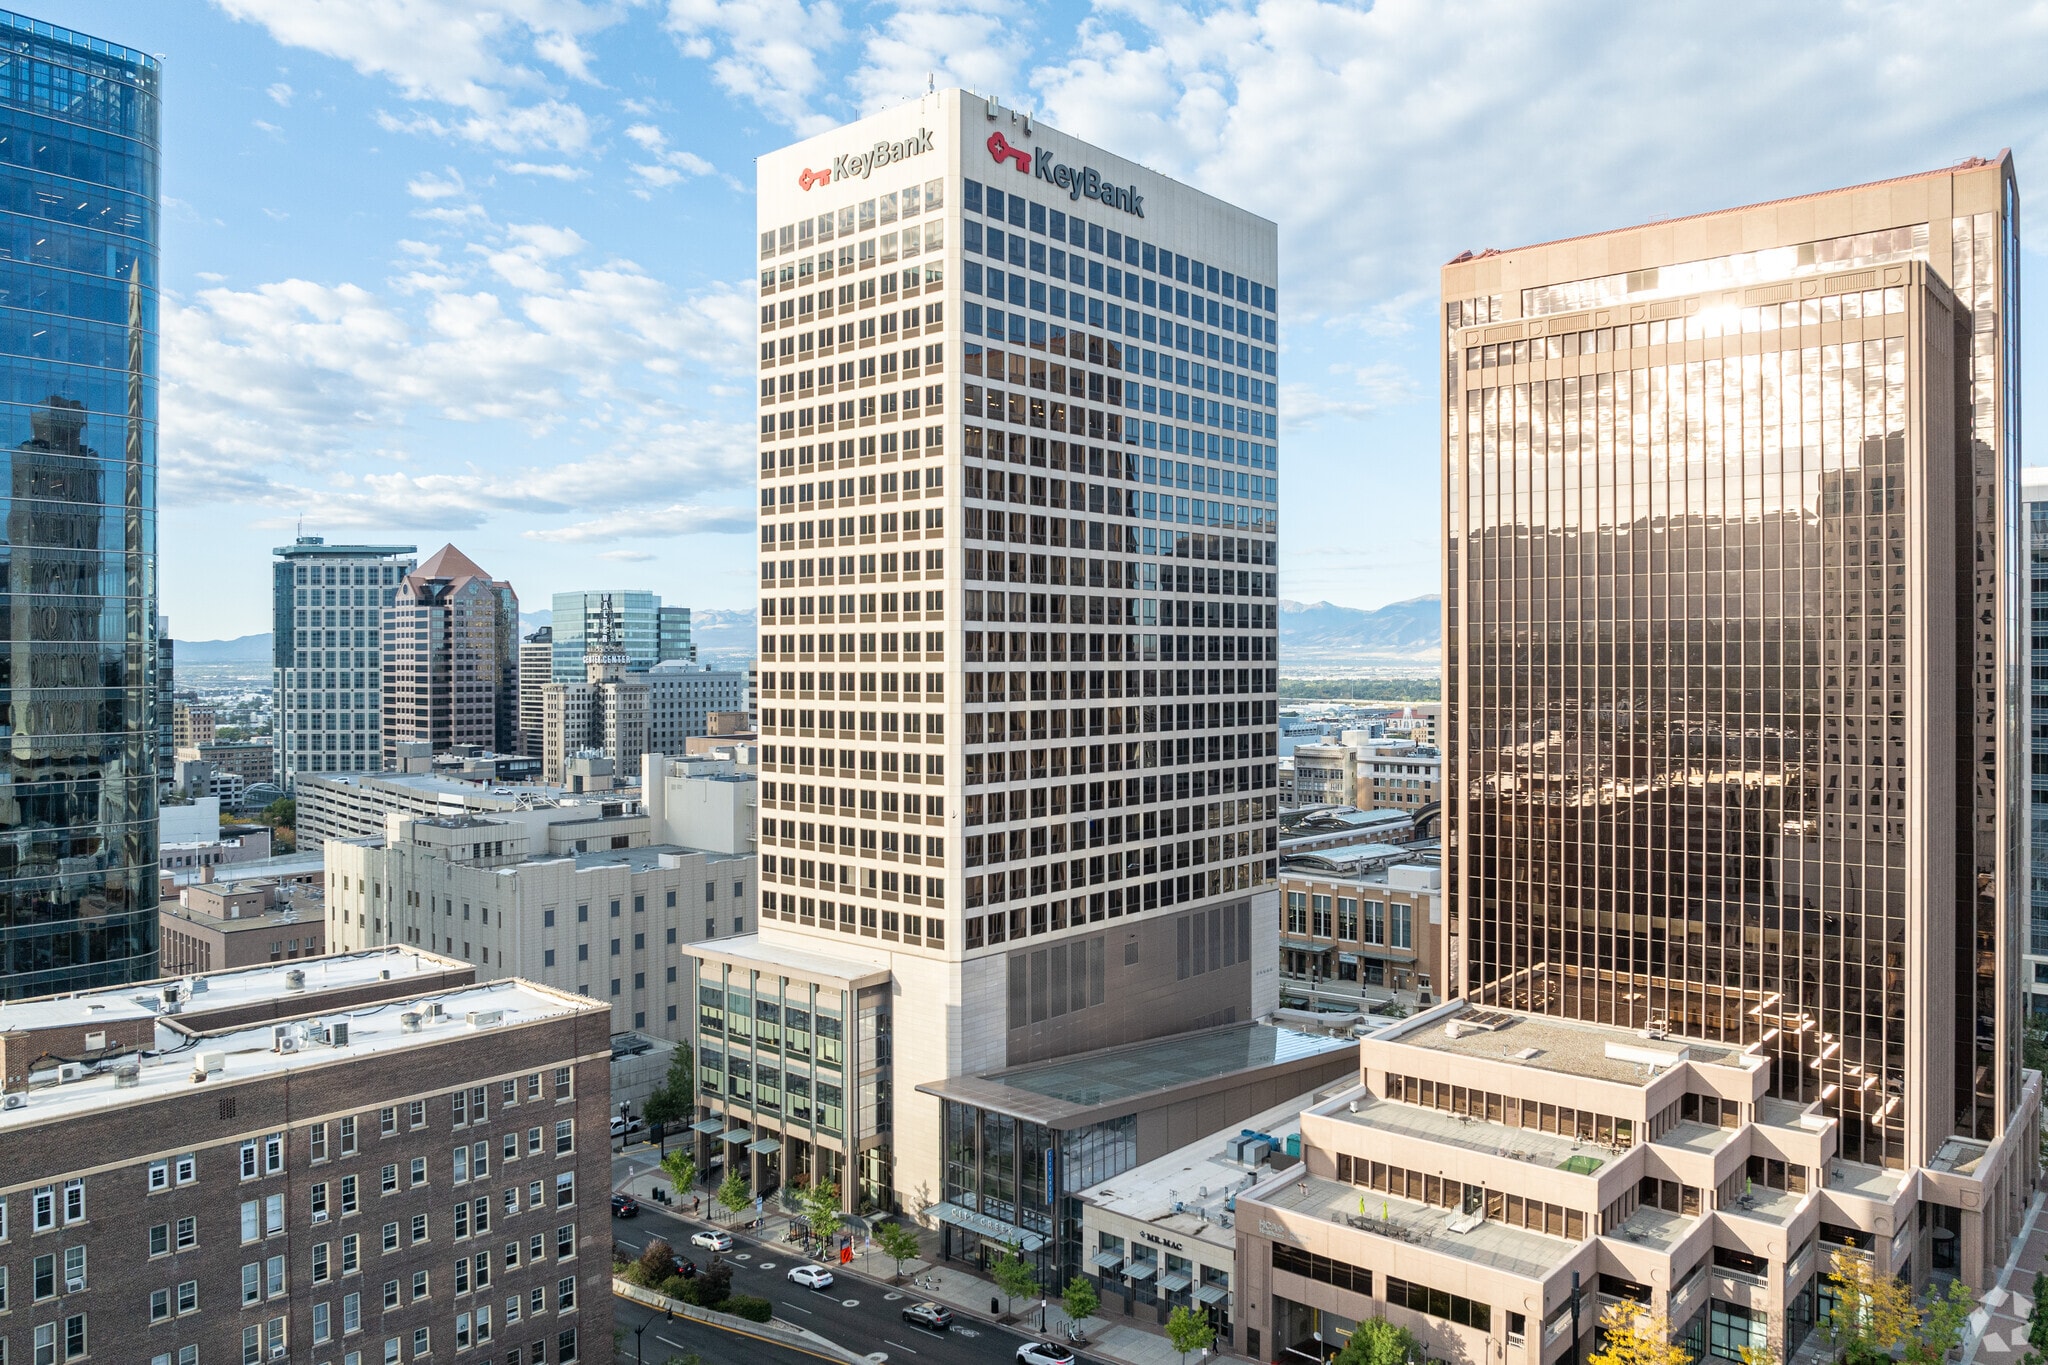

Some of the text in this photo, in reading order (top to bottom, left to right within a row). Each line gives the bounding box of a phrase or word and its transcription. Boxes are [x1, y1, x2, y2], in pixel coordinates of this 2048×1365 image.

[833, 127, 934, 182] KeyBank
[1035, 146, 1145, 218] KeyBank
[602, 655, 631, 664] CENTER
[951, 1208, 1014, 1237] CITY CREEK
[1162, 1238, 1183, 1251] MAC
